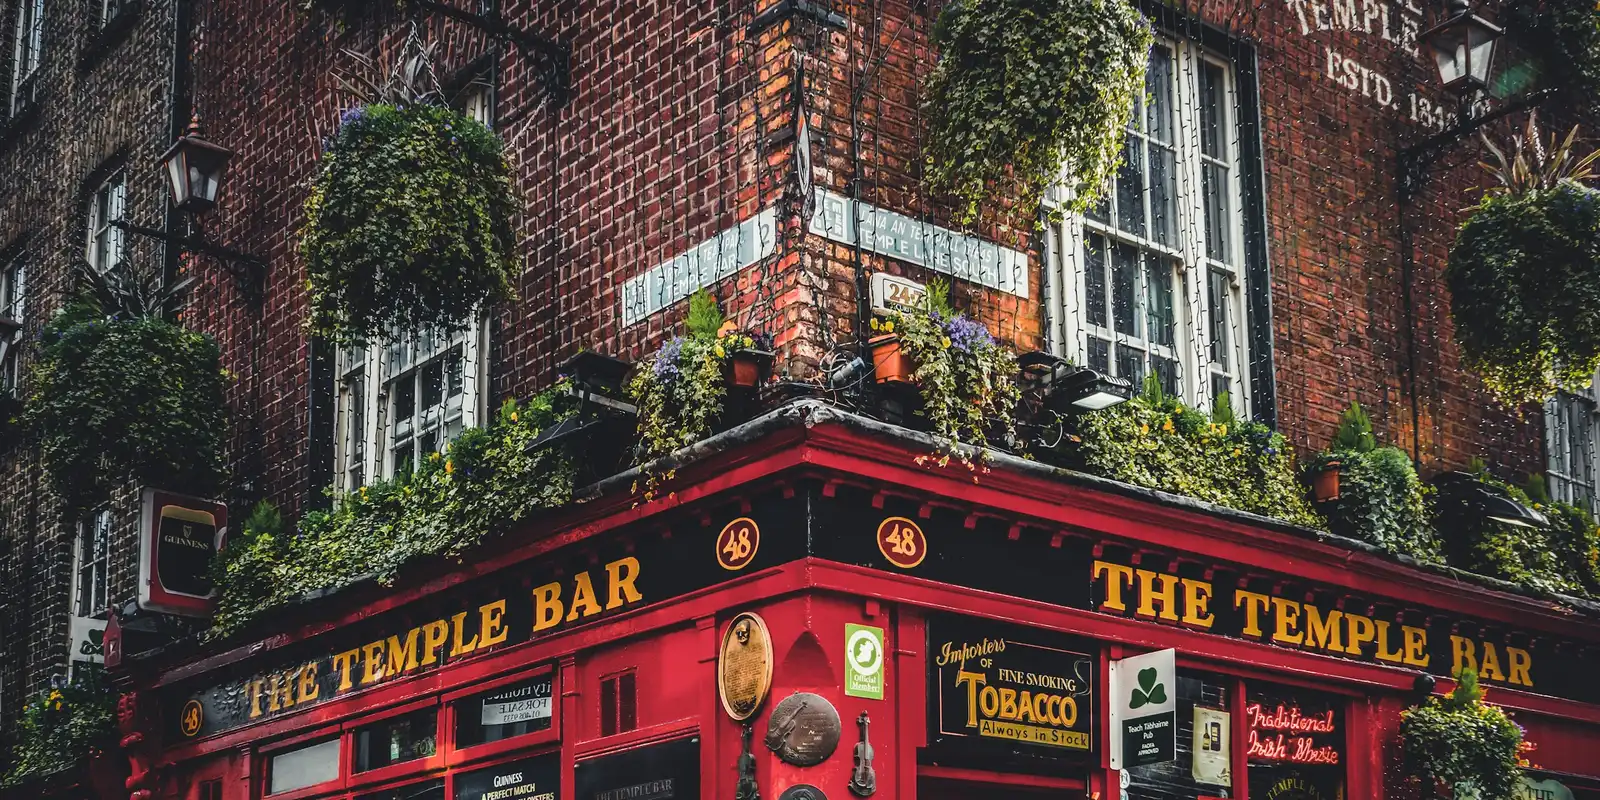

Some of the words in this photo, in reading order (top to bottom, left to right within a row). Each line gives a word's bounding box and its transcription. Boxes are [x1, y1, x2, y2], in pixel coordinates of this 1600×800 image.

[1285, 0, 1421, 58] TEMPLE
[891, 219, 906, 235] AN
[860, 228, 909, 255] TEMPLE
[953, 256, 998, 284] SOUTH
[164, 534, 209, 551] GUINNESS
[722, 527, 752, 561] 48
[885, 523, 917, 556] 48
[1092, 560, 1215, 630] THE
[1235, 589, 1431, 668] TEMPLE
[1449, 634, 1534, 687] BAR
[244, 662, 319, 719] THE
[333, 599, 509, 693] TEMPLE
[532, 556, 643, 632] BAR
[936, 637, 1006, 671] Importers
[980, 658, 993, 669] OF
[853, 674, 877, 684] Official
[998, 668, 1025, 684] FINE
[1026, 672, 1077, 692] SMOKING
[184, 707, 199, 731] 48
[1246, 703, 1344, 732] Traditional
[981, 721, 1029, 739] Always
[1034, 727, 1047, 741] in
[1050, 729, 1089, 747] Stock
[1143, 730, 1154, 740] Pub
[1246, 729, 1295, 759] Irish
[487, 787, 513, 800] PERFECT
[513, 782, 536, 797] MATCH
[493, 771, 524, 788] GUINNESS
